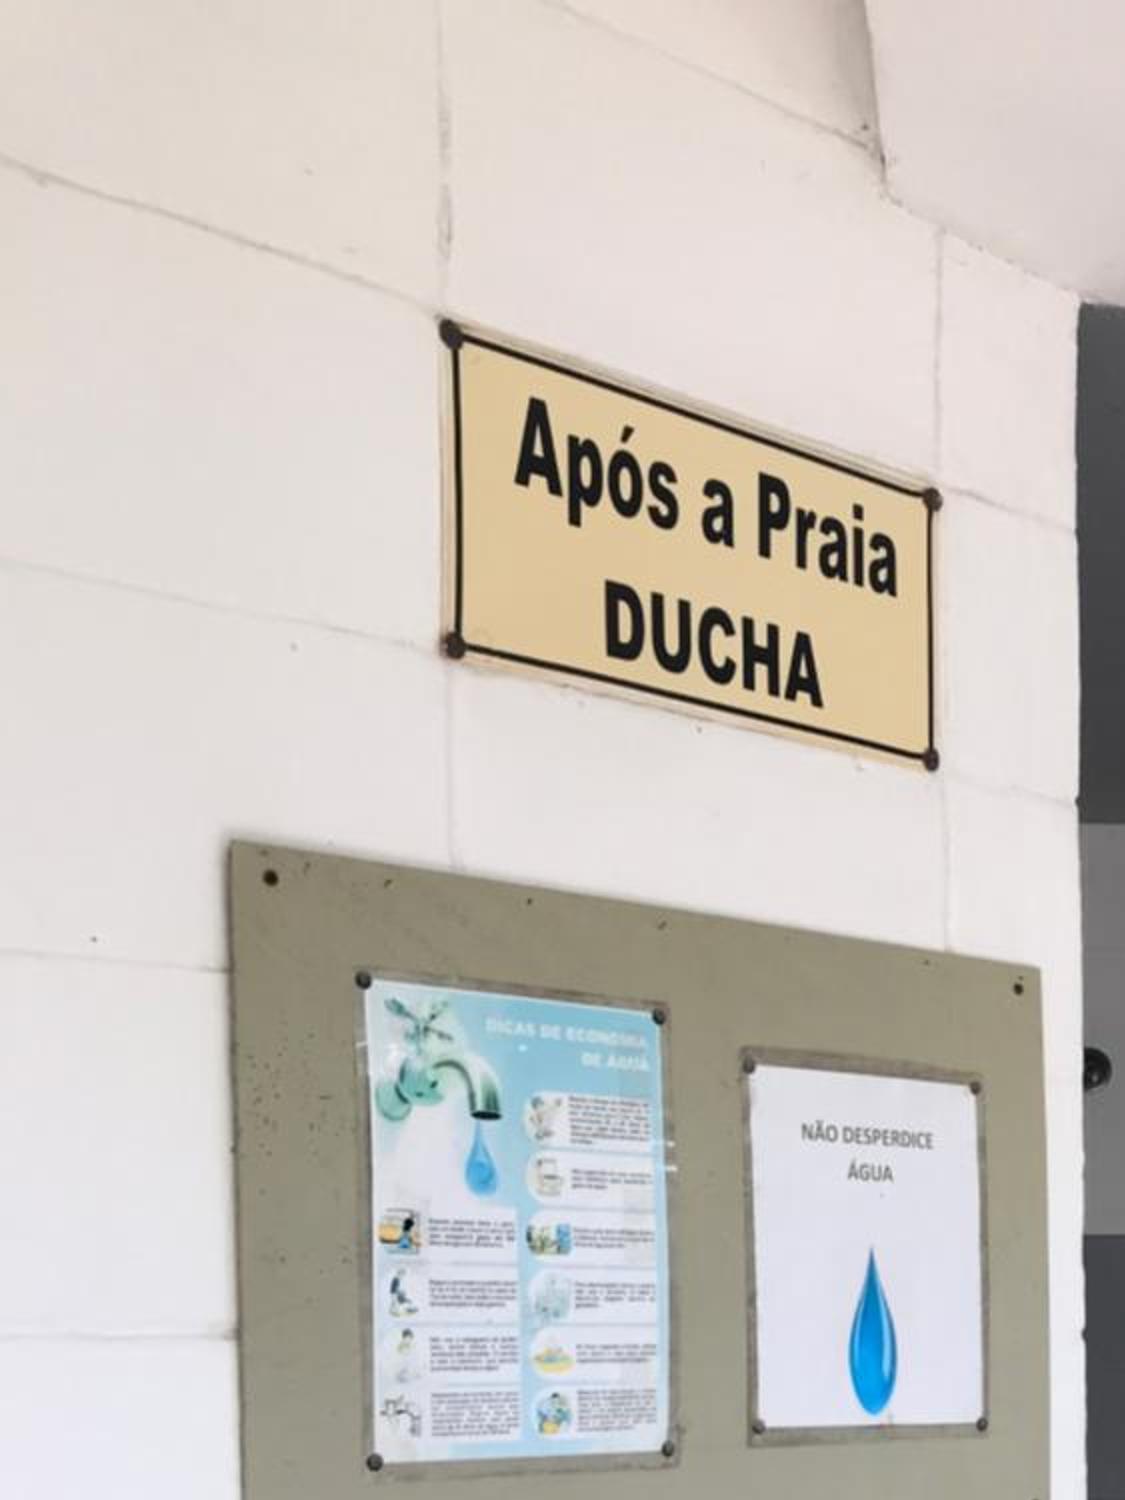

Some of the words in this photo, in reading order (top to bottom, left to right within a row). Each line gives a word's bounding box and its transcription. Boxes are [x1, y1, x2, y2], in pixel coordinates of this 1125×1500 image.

[515, 396, 679, 528] Após
[701, 479, 735, 548] a
[757, 471, 897, 597] Praia
[604, 579, 824, 708] DUCHA
[484, 1016, 537, 1038] DICAS
[539, 1023, 562, 1041] DE
[564, 1025, 648, 1049] ECONOMIA
[580, 1051, 602, 1068] DE
[801, 1120, 839, 1143] NÃO
[842, 1125, 934, 1150] DESPERDICE
[847, 1157, 895, 1183] ÁGUA
